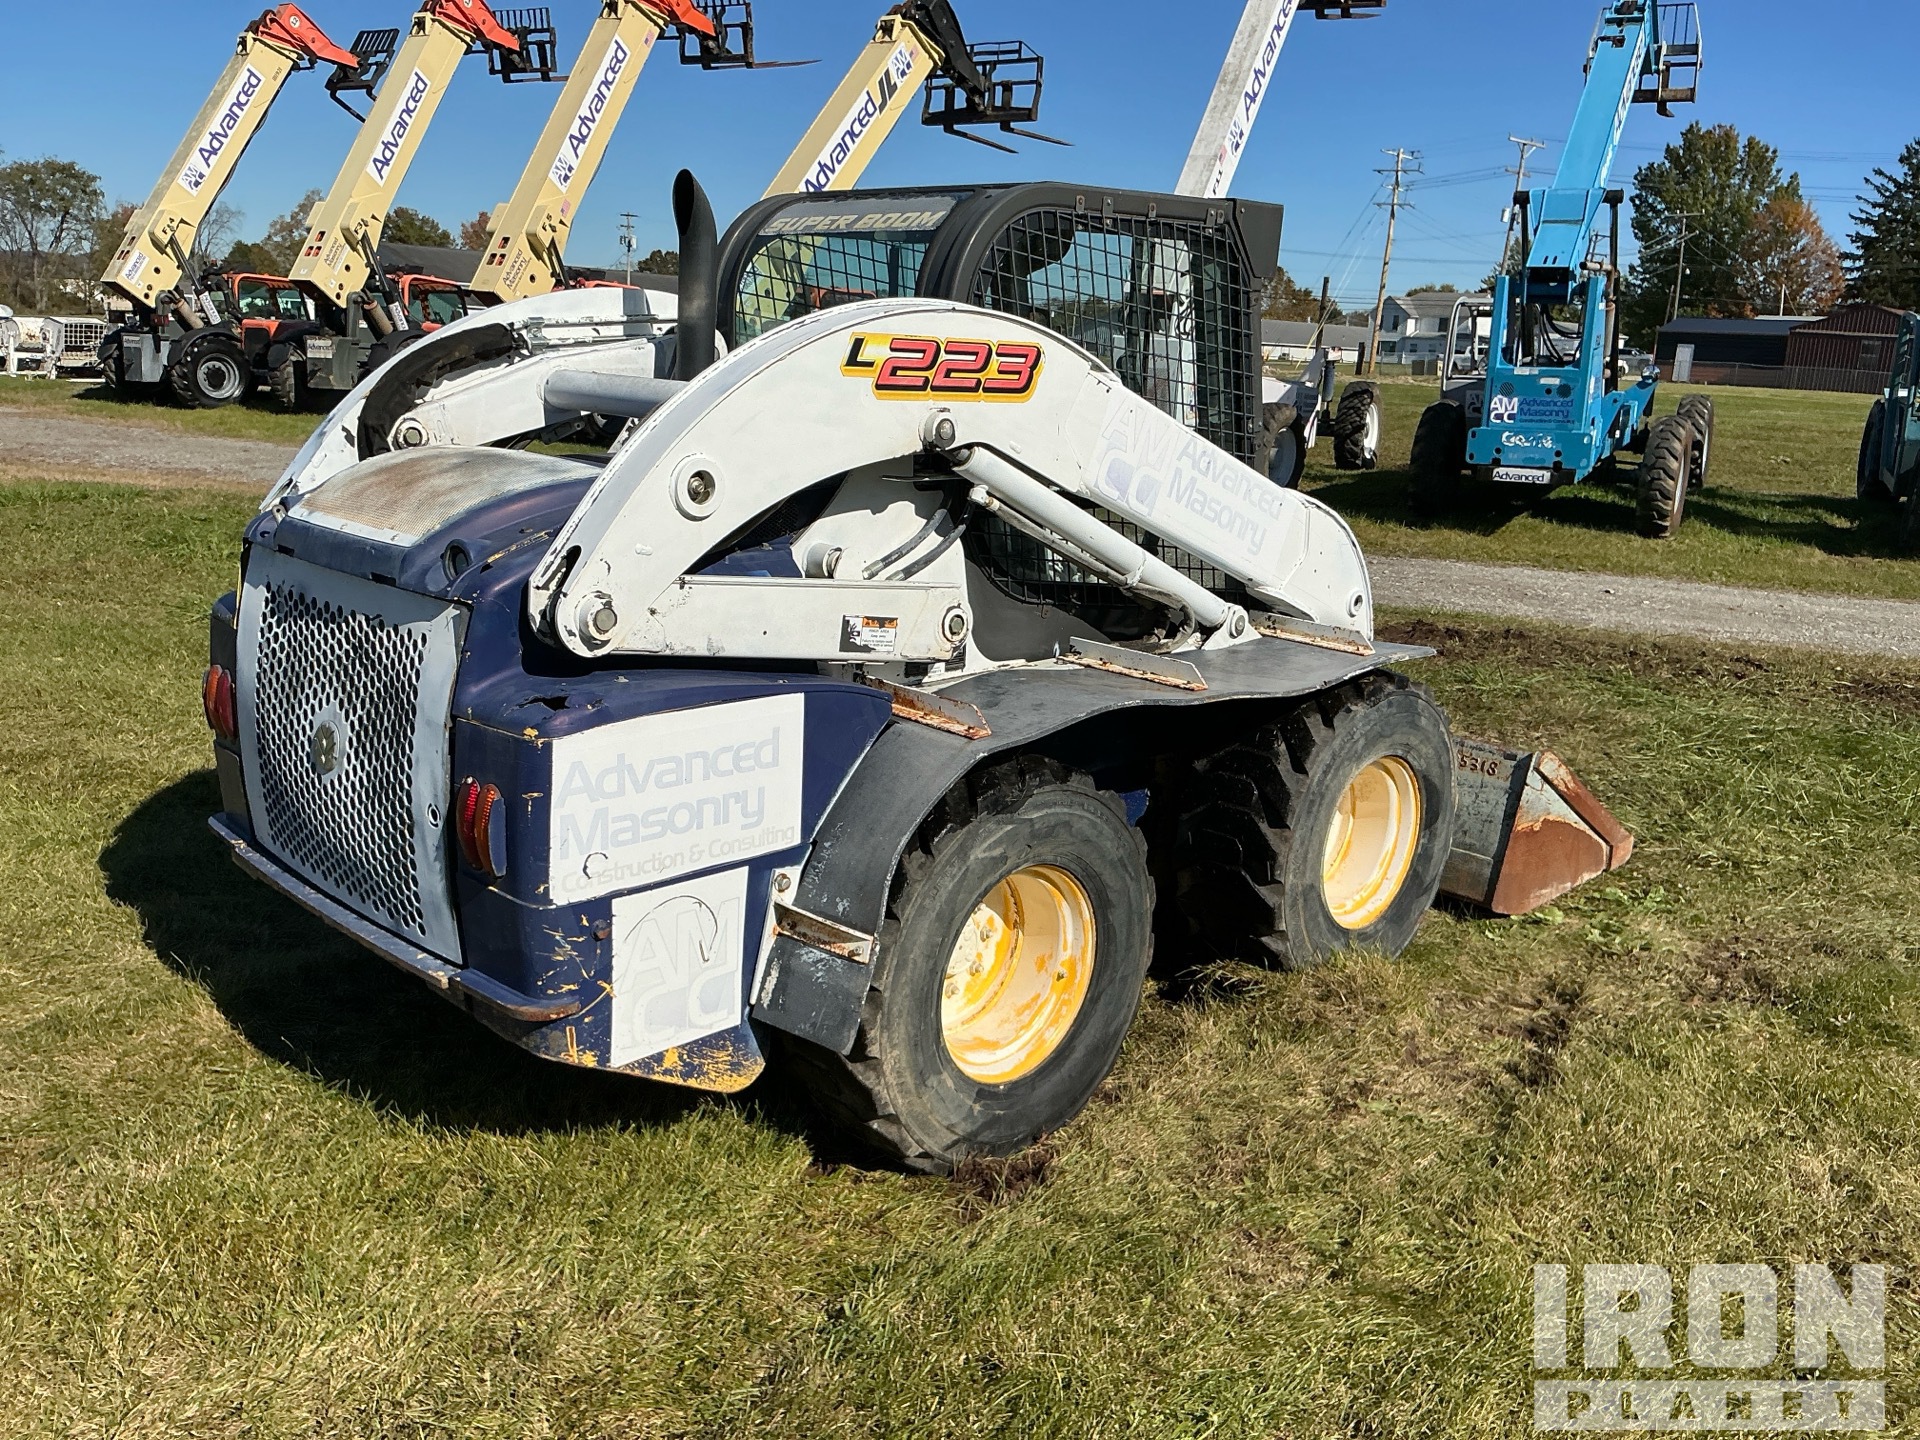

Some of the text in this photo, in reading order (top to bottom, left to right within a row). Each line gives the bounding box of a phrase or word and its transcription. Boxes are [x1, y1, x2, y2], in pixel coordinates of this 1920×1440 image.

[198, 67, 262, 169] Advanced
[569, 39, 628, 159] Advanced
[372, 71, 428, 181] Advanced
[804, 89, 878, 193] Advanced
[1212, 169, 1224, 196] F11
[765, 210, 948, 233] SUPER BOOM
[502, 248, 523, 285] Advanced
[506, 256, 528, 290] Masonry
[1489, 410, 1517, 424] CC
[1490, 396, 1519, 413] AM
[1519, 407, 1570, 418] Masonry
[1520, 397, 1574, 408] Advanced
[1176, 436, 1284, 521] Advanced
[1492, 470, 1546, 482] Advanced
[1167, 466, 1269, 556] Masonry
[553, 726, 781, 809] Advanced
[559, 786, 766, 860] Masonry
[561, 825, 796, 894] Construction & Consulting
